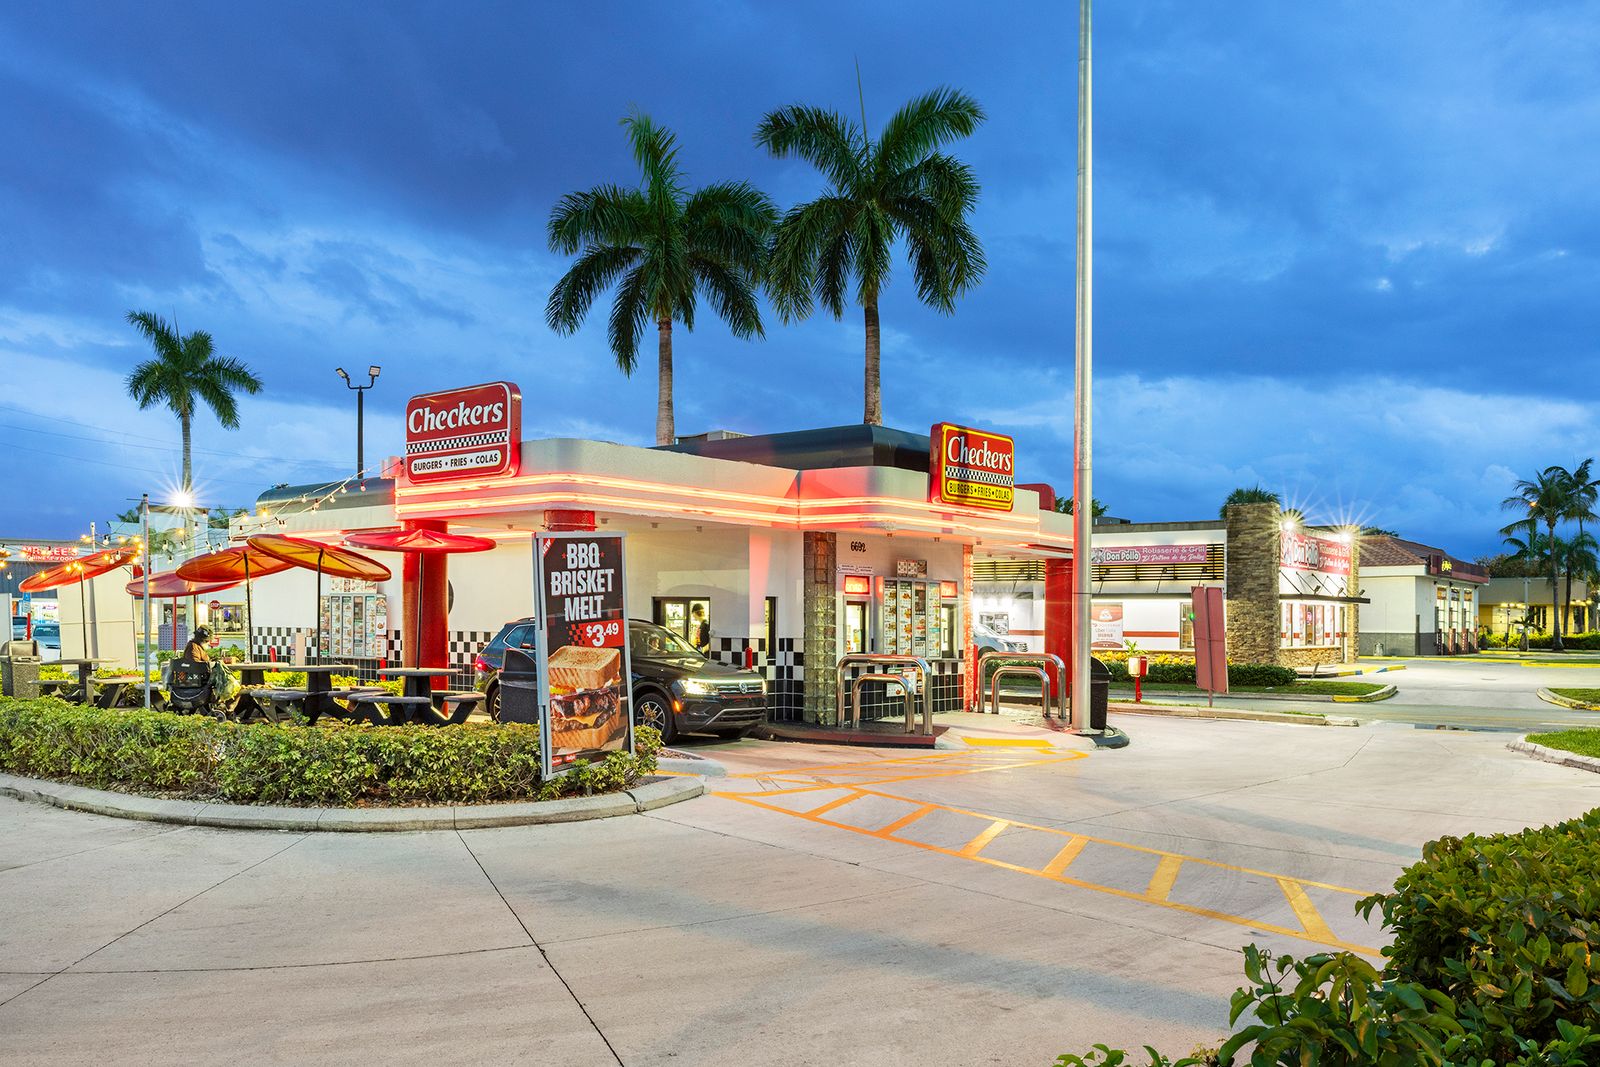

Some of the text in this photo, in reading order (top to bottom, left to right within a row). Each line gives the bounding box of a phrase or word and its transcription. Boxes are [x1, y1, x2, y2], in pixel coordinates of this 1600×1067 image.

[408, 401, 504, 434] Checkers
[413, 453, 498, 472] BURGERS FRIES COLAS
[947, 436, 1011, 472] Checkers
[949, 482, 1010, 500] BURGERS FRIES COLAS
[566, 542, 601, 569] BBQ
[850, 541, 867, 553] 6692
[1106, 550, 1139, 561] Don Pollo
[551, 568, 615, 596] BRISKET
[564, 595, 604, 622] MELT
[586, 622, 619, 647] $3.49
